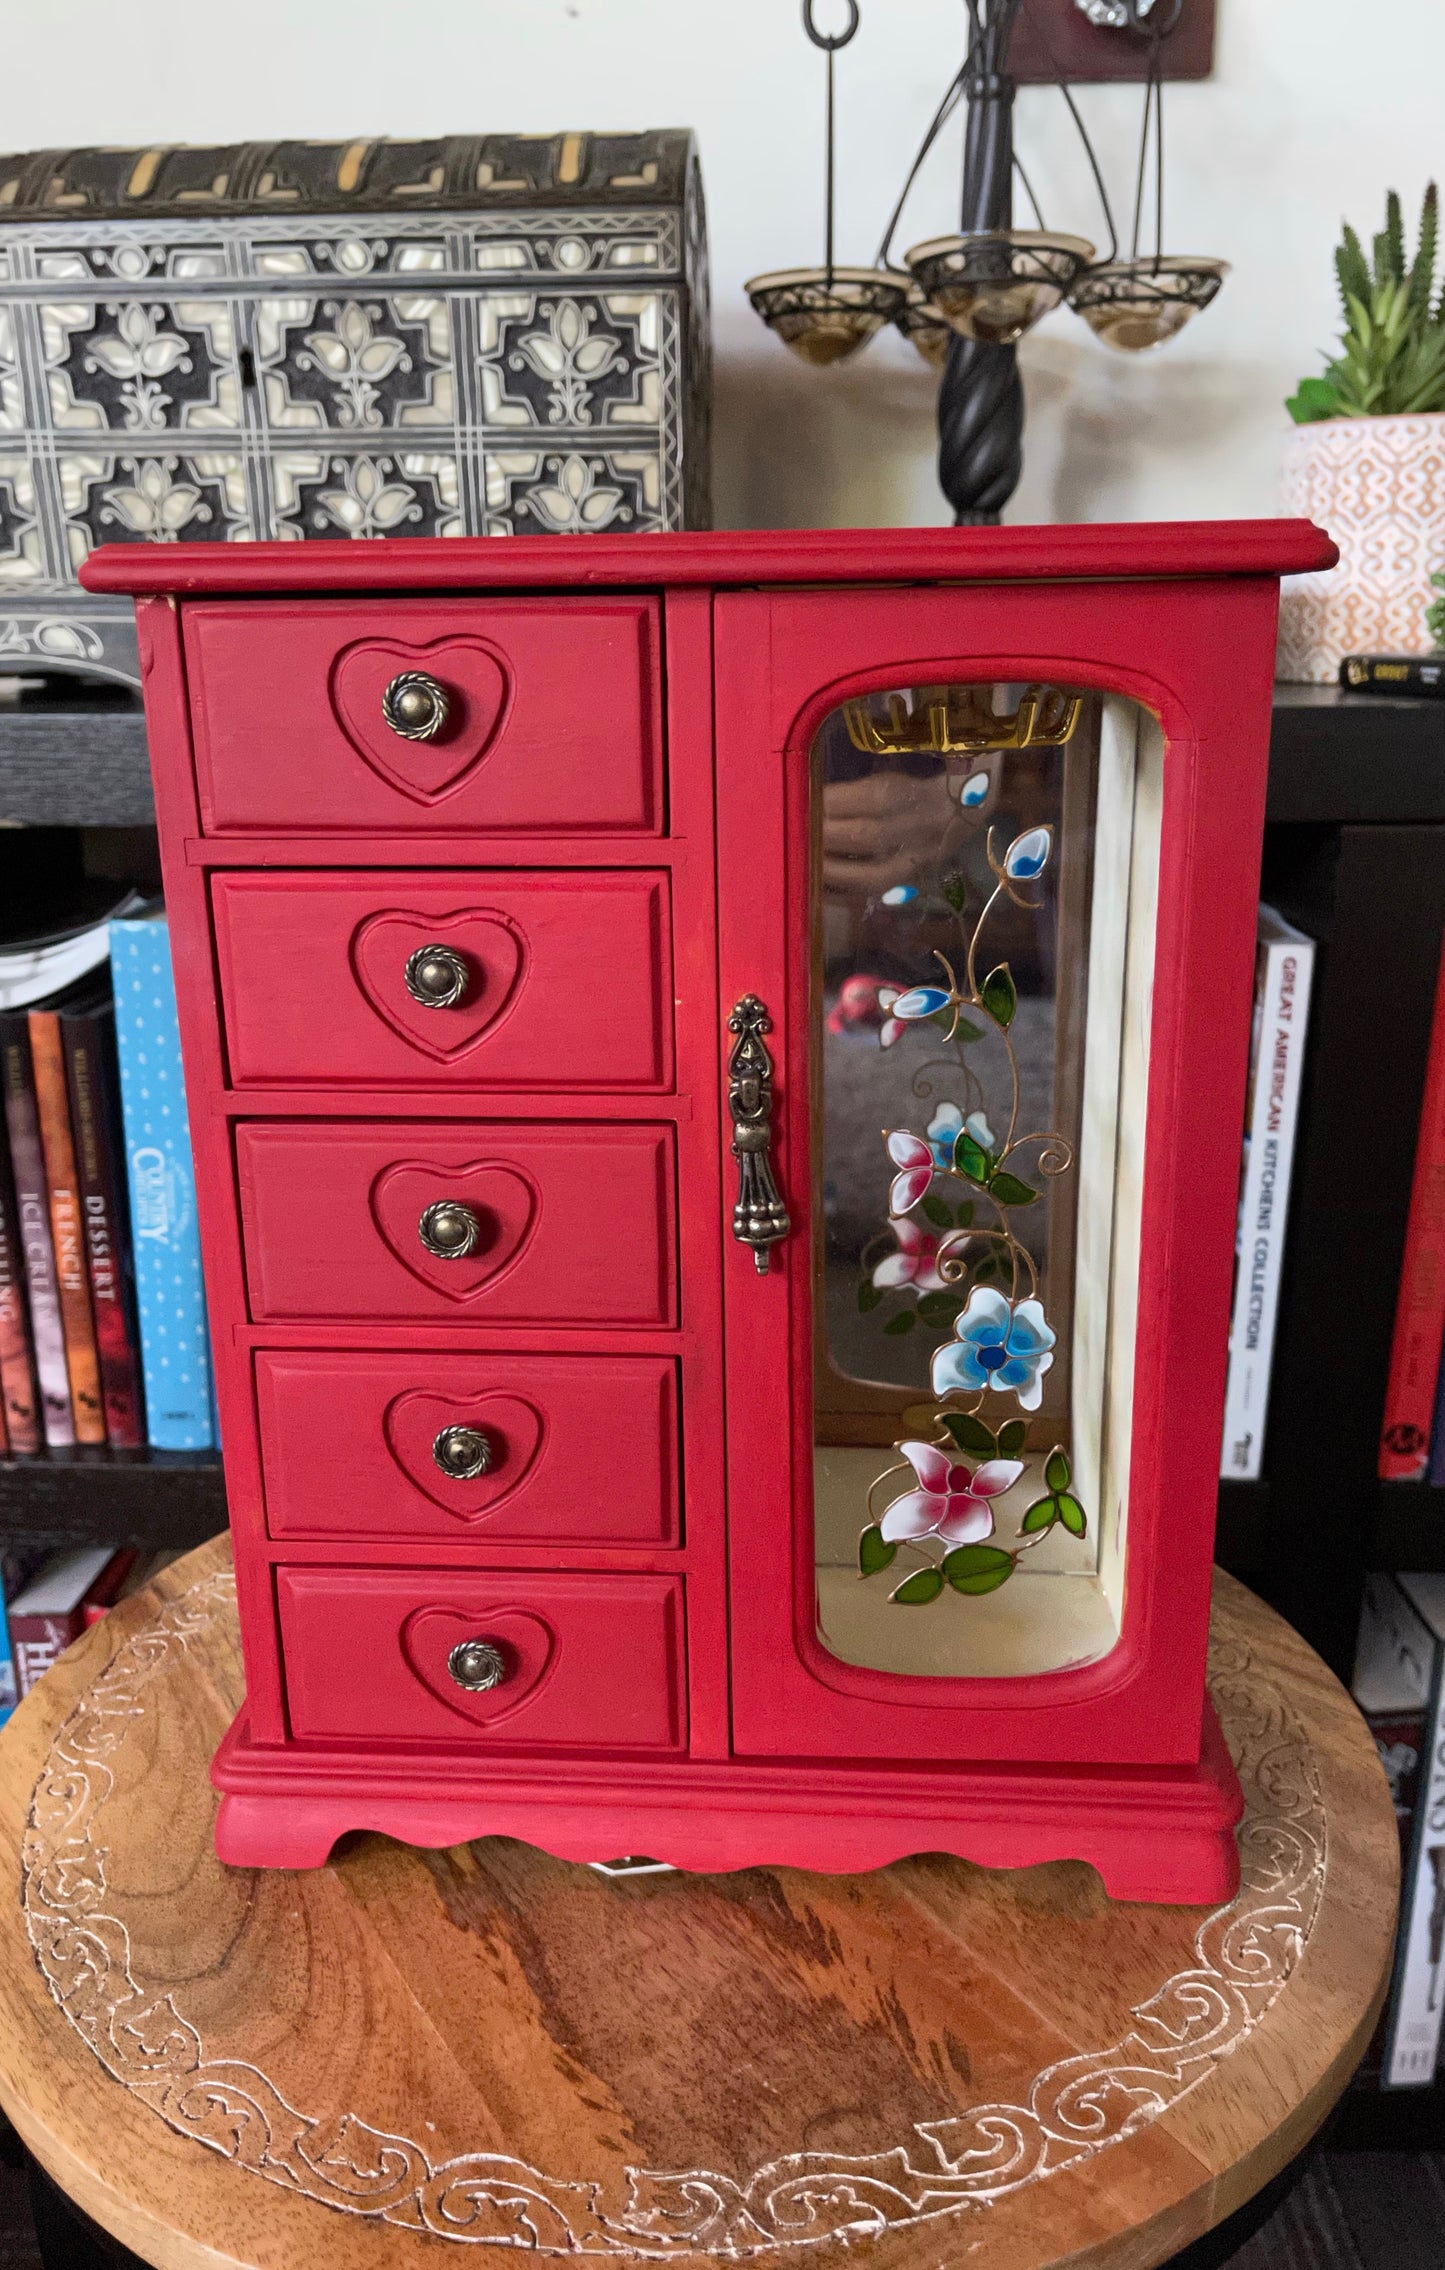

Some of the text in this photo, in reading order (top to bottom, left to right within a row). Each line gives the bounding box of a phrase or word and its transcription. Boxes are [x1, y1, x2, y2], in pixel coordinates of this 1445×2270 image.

[1278, 956, 1298, 1022] GREAT
[1267, 1028, 1291, 1132] AMERICAN
[132, 1147, 170, 1245] COUNTRY
[1256, 1138, 1279, 1230] KITCHENS
[20, 1193, 57, 1327] ICE CREAM
[54, 1189, 82, 1290] FRENCH
[85, 1196, 115, 1302] DESSERT
[1245, 1237, 1270, 1350] COLLECTION
